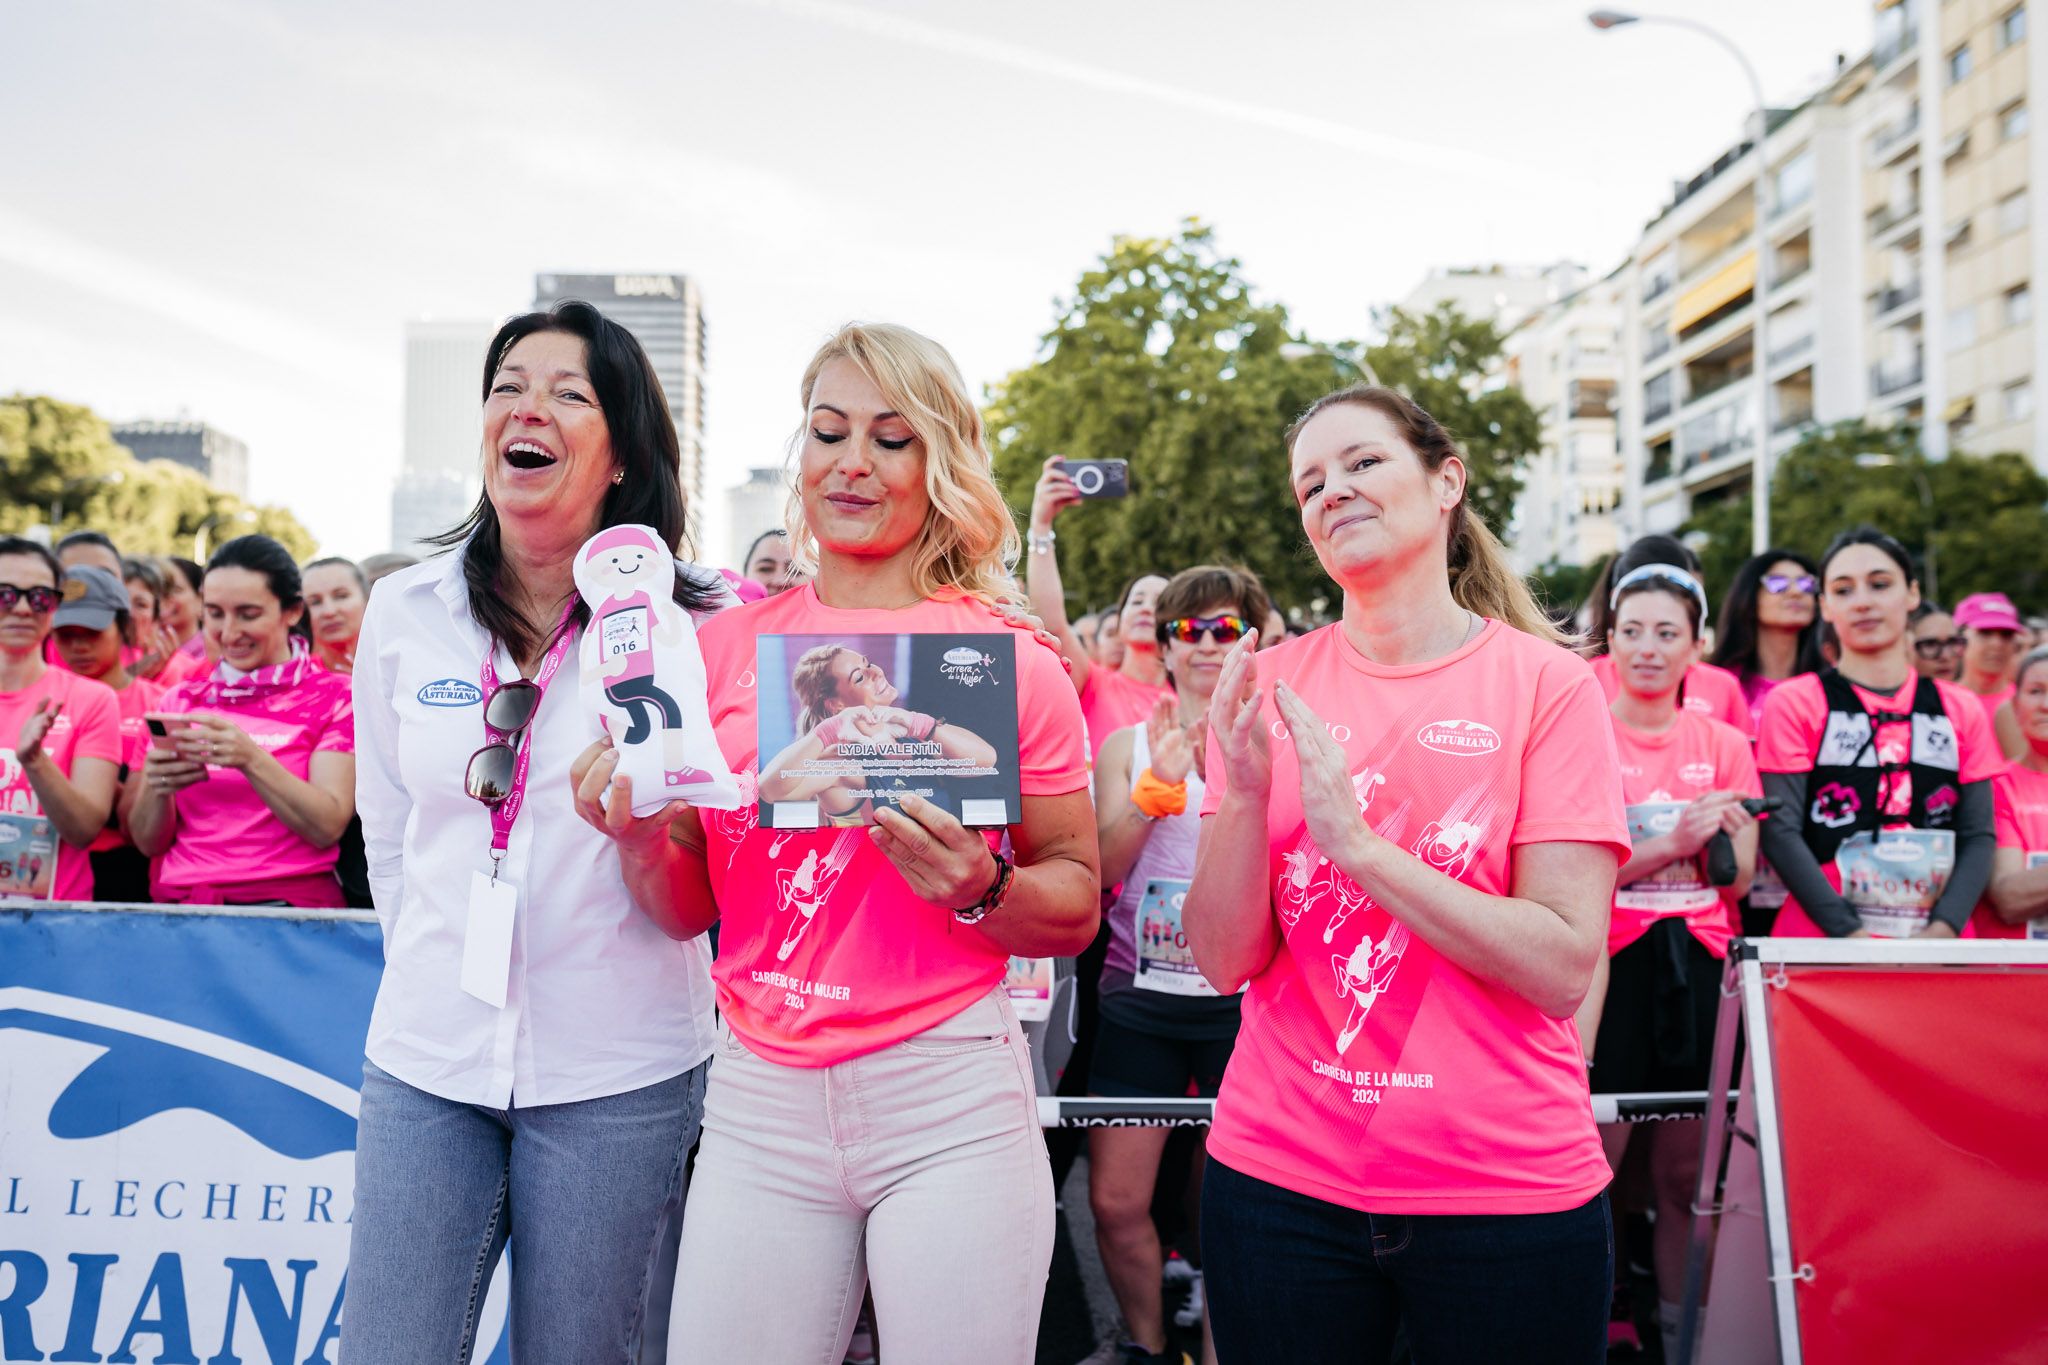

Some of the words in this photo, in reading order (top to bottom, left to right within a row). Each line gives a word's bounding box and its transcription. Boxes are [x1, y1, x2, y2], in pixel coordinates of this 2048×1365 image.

[613, 641, 636, 654] 016
[940, 663, 973, 673] Carrera
[959, 671, 984, 687] Mujer
[421, 688, 477, 702] ASTURIANA
[1423, 728, 1494, 749] ASTURIANA
[838, 743, 876, 755] LYDIA
[878, 741, 942, 755] VALENTÍN
[875, 758, 903, 767] barreras
[922, 758, 948, 768] deporte
[948, 759, 976, 768] español
[870, 768, 897, 778] mejores
[848, 789, 875, 798] Madrid,
[751, 970, 788, 989] CARRERA
[788, 977, 799, 992] DE
[800, 980, 812, 995] LA
[814, 982, 850, 1001] MUJER
[784, 992, 805, 1010] 2024
[1312, 1059, 1353, 1085] CARRERA
[1355, 1071, 1371, 1086] DE
[1374, 1071, 1389, 1087] LA
[1392, 1072, 1434, 1089] MUJER
[1352, 1088, 1381, 1104] 2024
